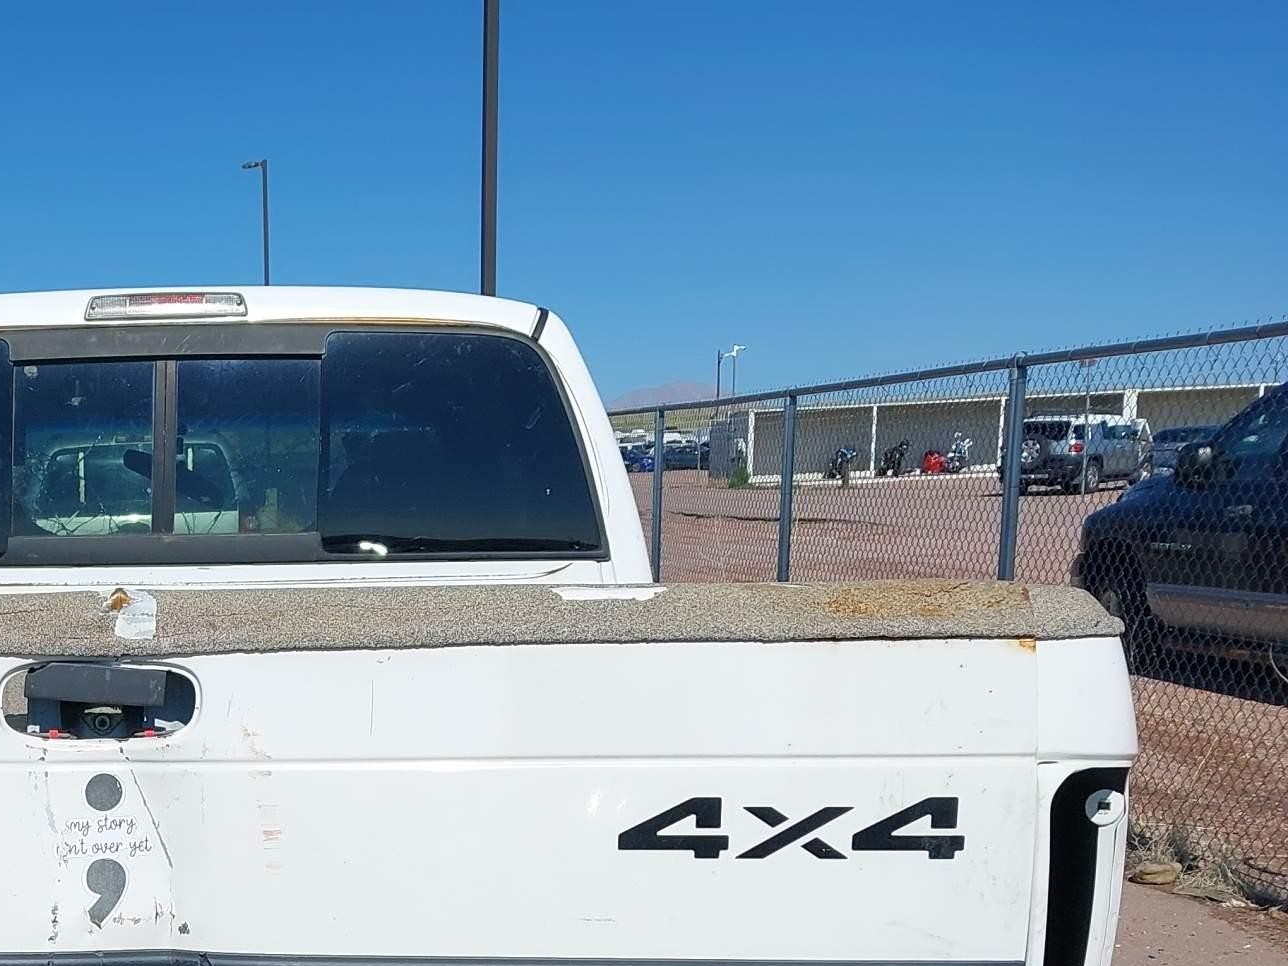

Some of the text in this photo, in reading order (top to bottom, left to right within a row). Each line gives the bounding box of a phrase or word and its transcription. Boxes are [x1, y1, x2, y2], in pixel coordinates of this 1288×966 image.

[66, 814, 136, 837] my story
[617, 796, 966, 860] 4X4
[92, 841, 123, 855] over
[129, 836, 153, 857] yet
